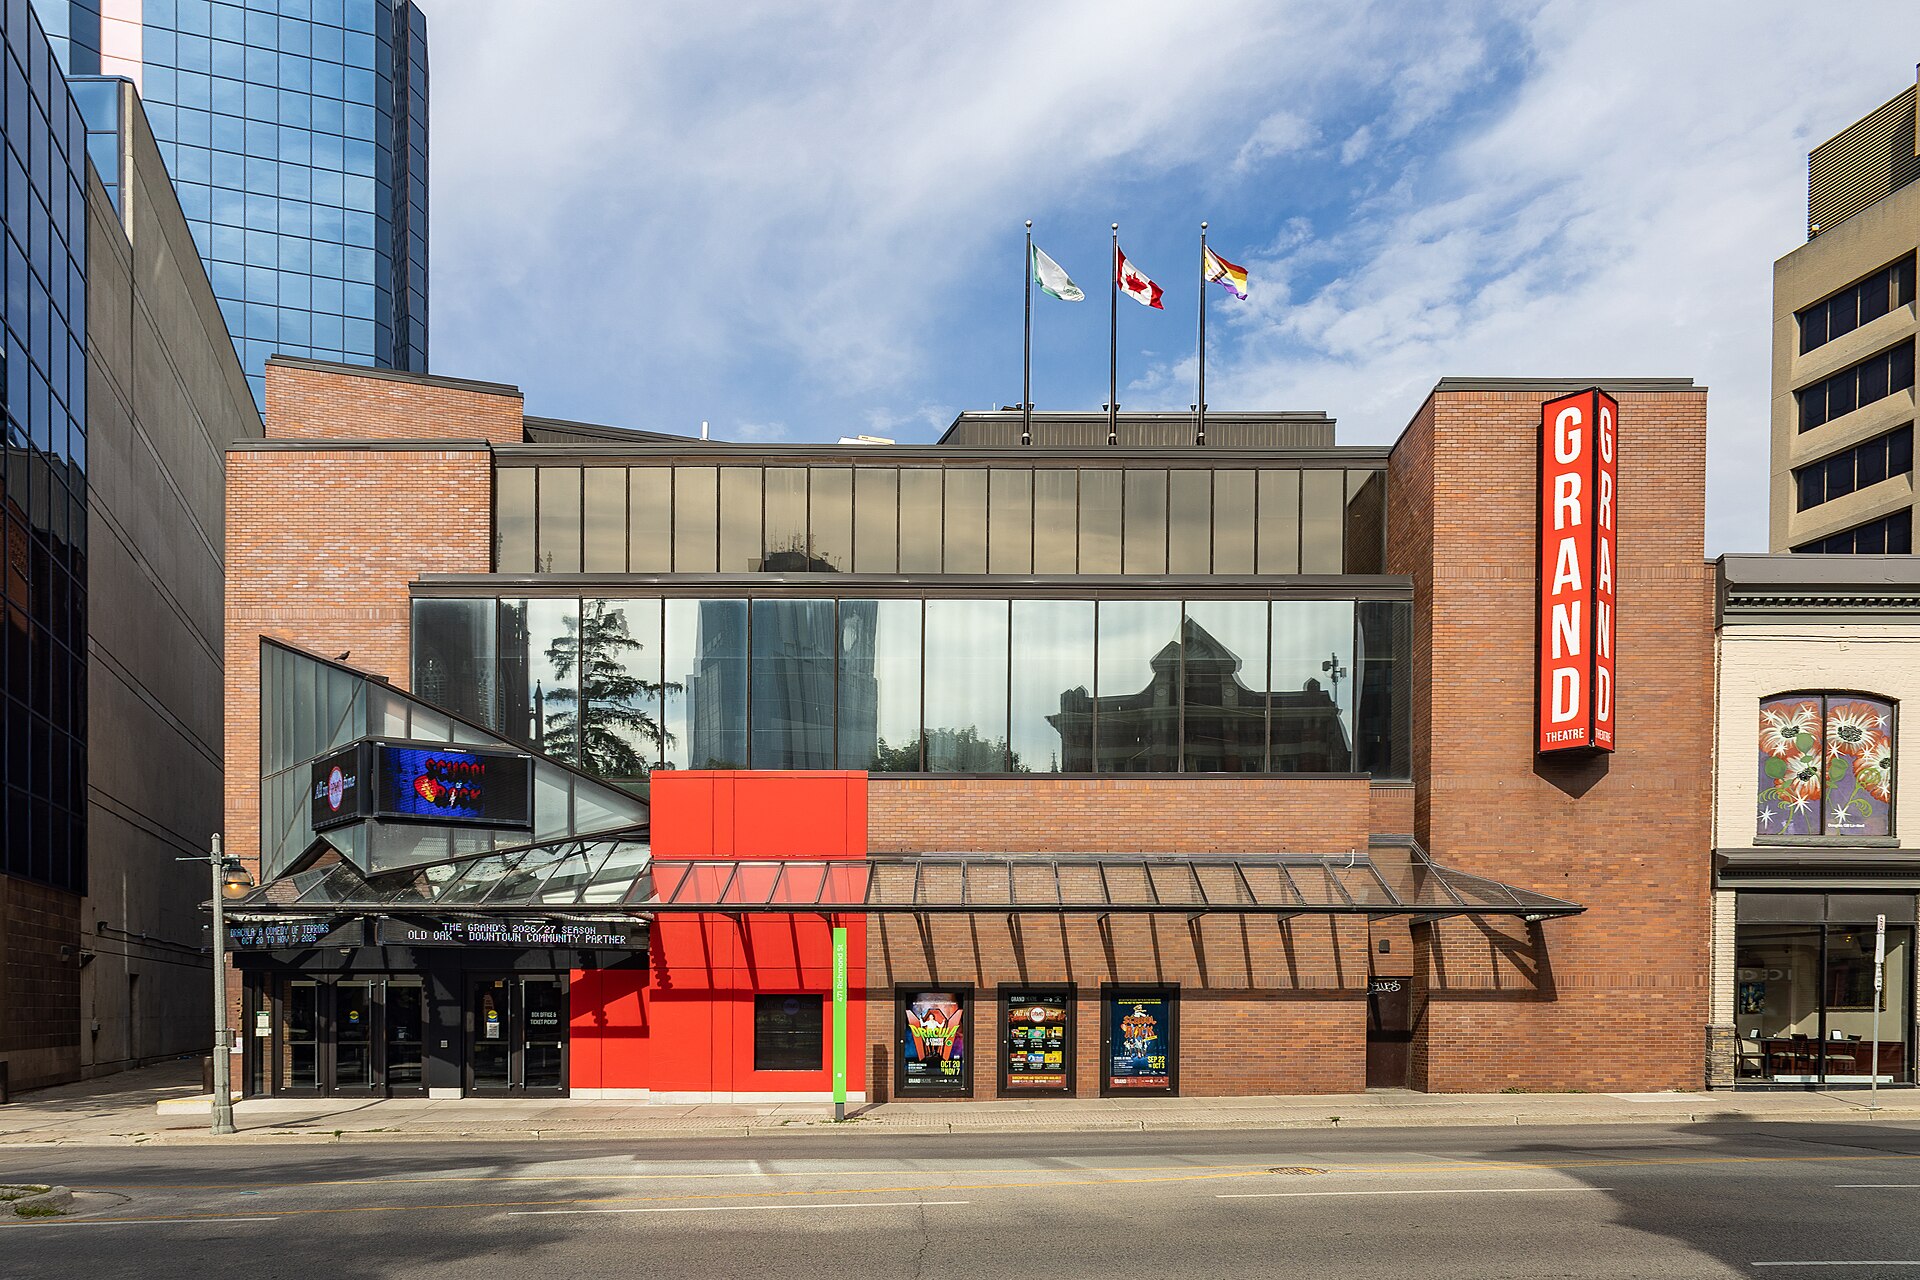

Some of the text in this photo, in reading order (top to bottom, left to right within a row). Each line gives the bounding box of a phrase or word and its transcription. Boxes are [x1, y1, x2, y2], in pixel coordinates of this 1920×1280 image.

[1552, 406, 1582, 724] GRAND
[1597, 406, 1613, 722] GRAND
[1545, 728, 1585, 742] THEATRE
[1595, 727, 1611, 742] THEATRE
[258, 927, 264, 935] A
[265, 925, 289, 936] COMEDY
[291, 925, 299, 935] OF
[302, 923, 330, 933] TERRORS
[442, 923, 596, 935] THE GRAND'S 2026/27 SEASON
[241, 936, 253, 945] OCT
[267, 935, 275, 944] TO
[277, 935, 289, 943] NOV
[408, 930, 427, 940] OLD
[433, 930, 453, 940] OAK
[468, 931, 522, 942] DOWNTOWN
[526, 932, 580, 943] COMMUNITY
[585, 934, 626, 944] PARTNER
[837, 944, 843, 952] St
[908, 1024, 960, 1042] DRACULA
